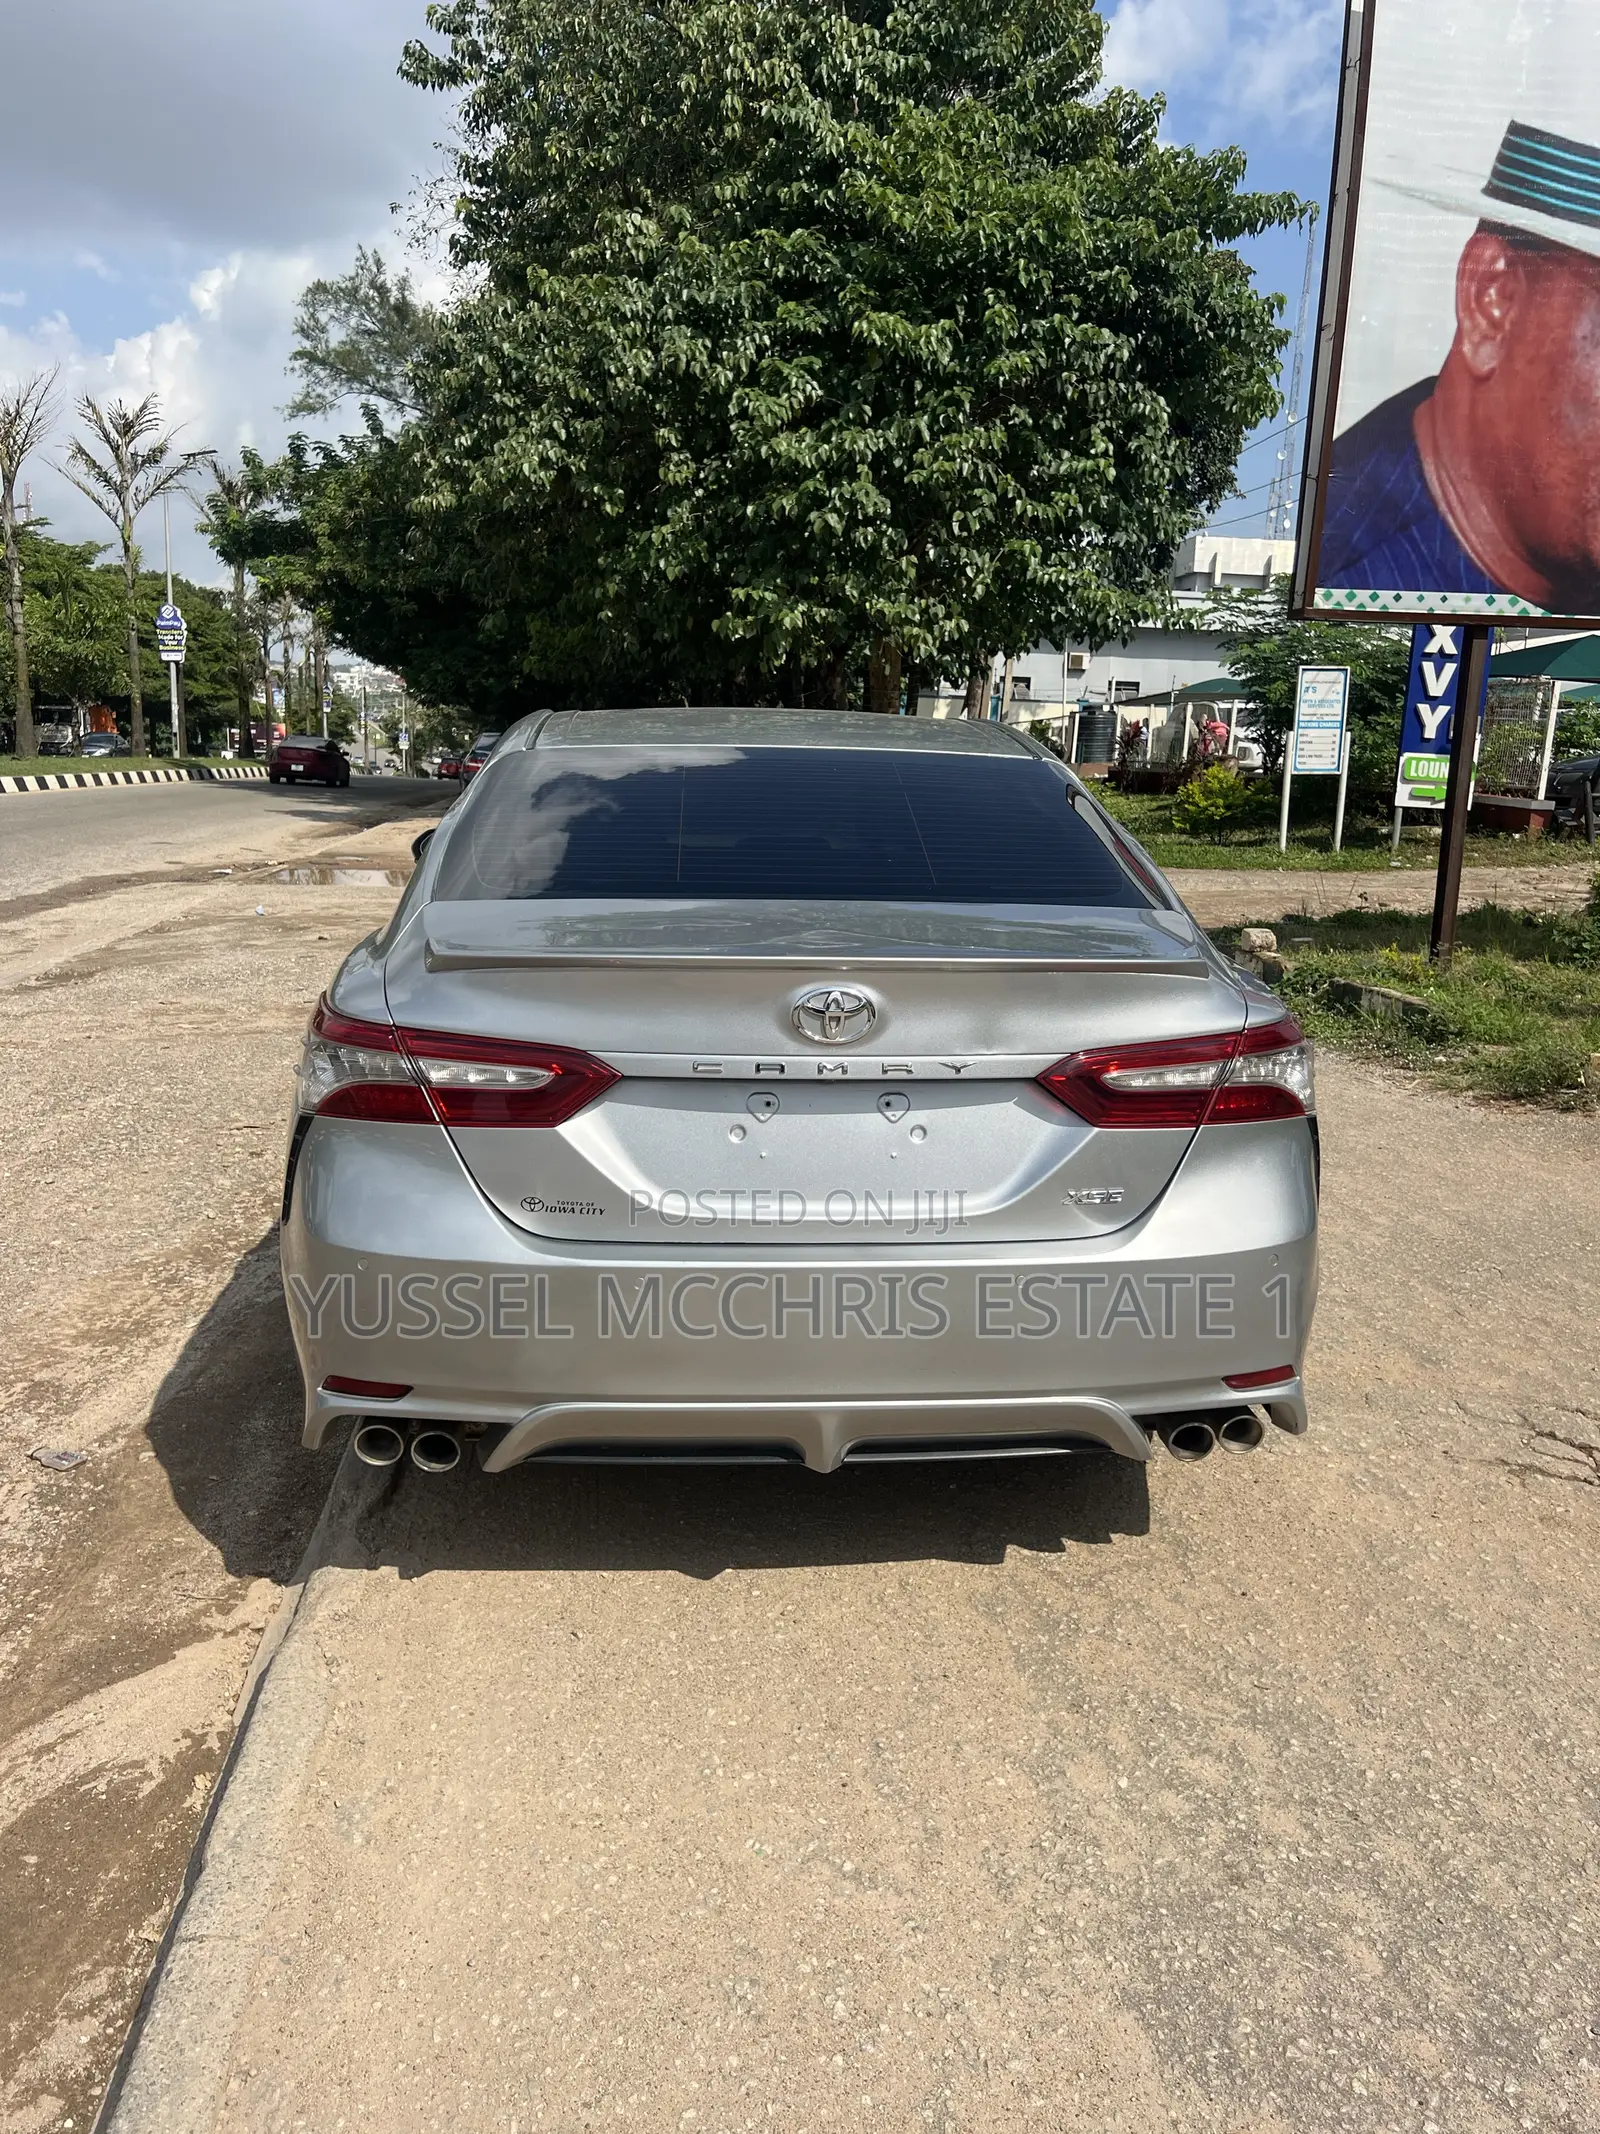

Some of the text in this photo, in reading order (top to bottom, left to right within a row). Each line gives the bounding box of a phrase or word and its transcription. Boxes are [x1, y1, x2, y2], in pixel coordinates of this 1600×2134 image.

[1410, 760, 1449, 778] LOUN
[691, 1060, 978, 1075] CAMRY
[1061, 1187, 1125, 1206] XSE
[544, 1205, 606, 1216] IOWA CITY
